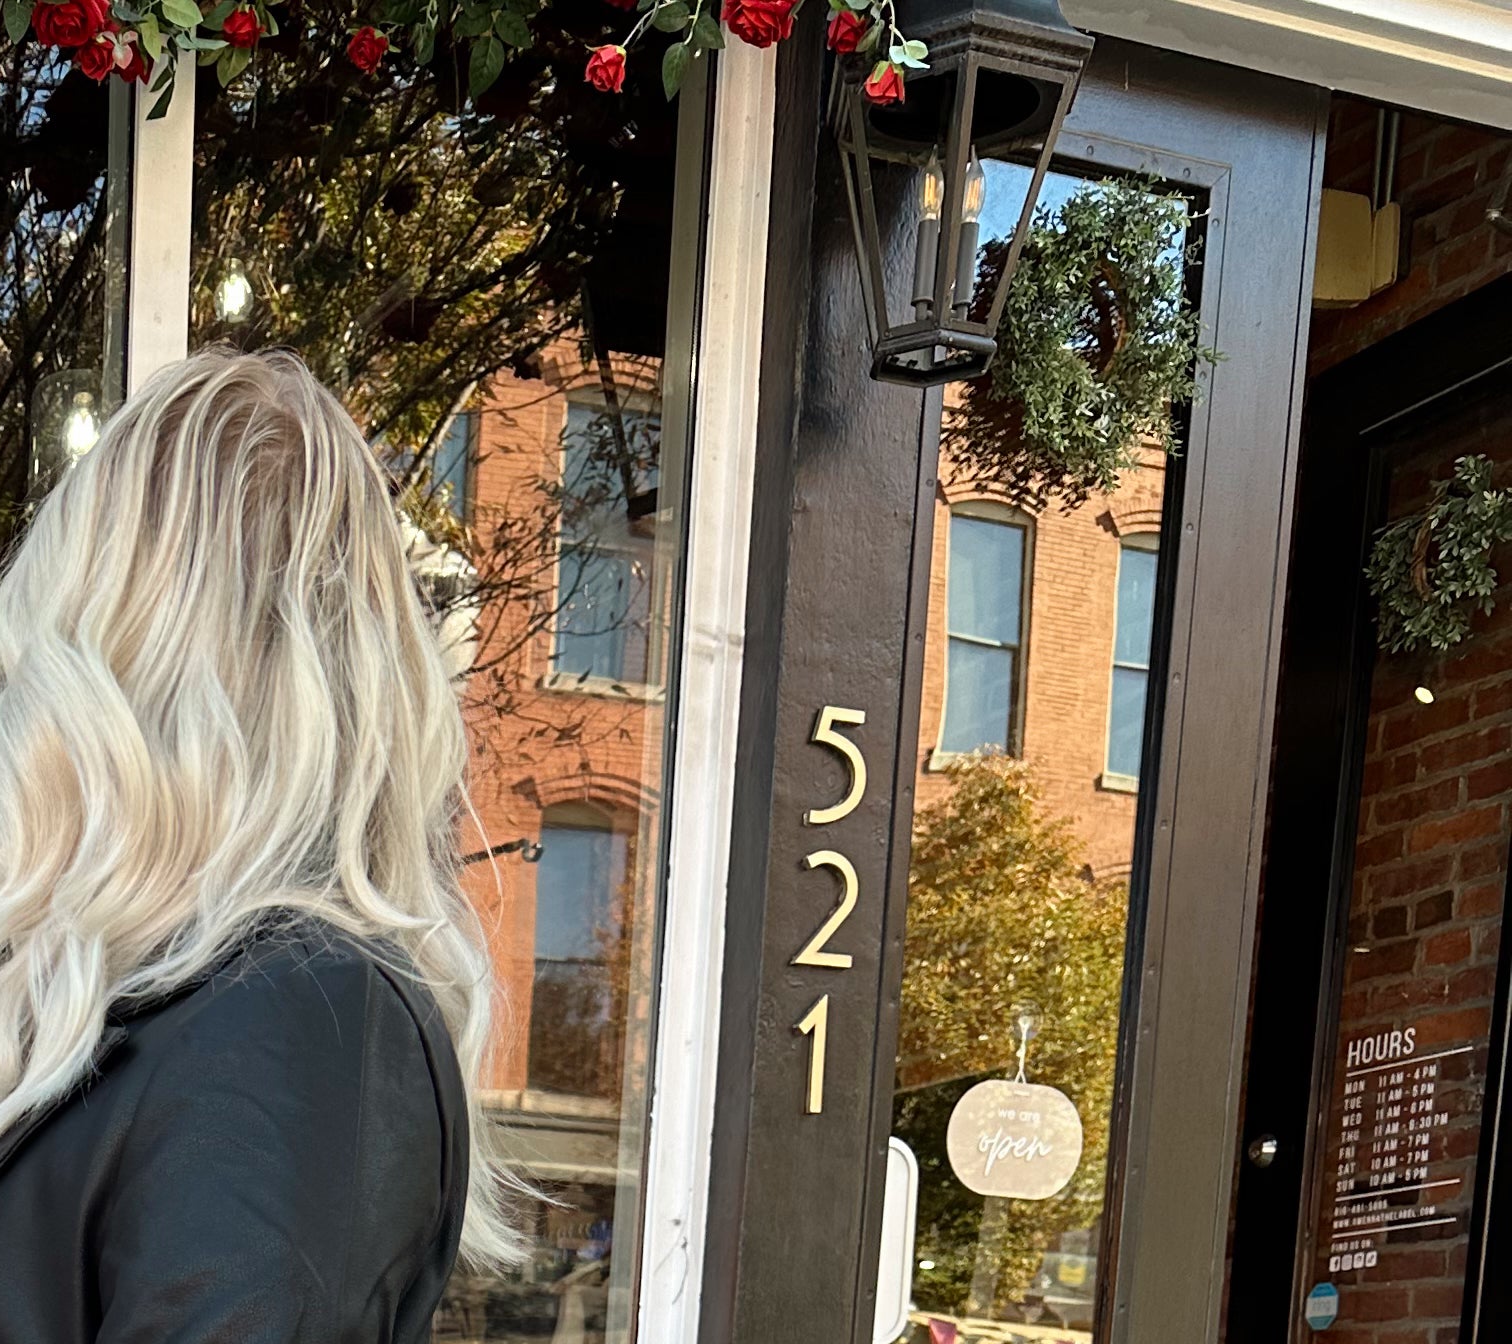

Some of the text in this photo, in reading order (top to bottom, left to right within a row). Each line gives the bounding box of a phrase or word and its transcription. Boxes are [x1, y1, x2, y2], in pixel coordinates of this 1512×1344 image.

[791, 705, 866, 1115] 521
[1347, 1027, 1416, 1067] HOURS
[1344, 1080, 1365, 1095] MON
[1390, 1072, 1404, 1084] AM
[1422, 1064, 1437, 1077] PM
[1388, 1088, 1402, 1102] AM
[1420, 1083, 1434, 1095] PM
[998, 1108, 1040, 1122] we are
[1387, 1105, 1401, 1118] AM
[1418, 1099, 1433, 1112] PM
[1385, 1122, 1399, 1135] AM
[1434, 1112, 1448, 1125] PM
[978, 1126, 1053, 1176] open
[1383, 1139, 1398, 1151] AM
[1415, 1133, 1430, 1146] PM
[1338, 1162, 1356, 1176] SAT
[1383, 1155, 1396, 1168] AM
[1414, 1150, 1429, 1162] PM
[1336, 1179, 1354, 1192] SUN
[1381, 1172, 1395, 1184] AM
[1413, 1167, 1428, 1180] PM
